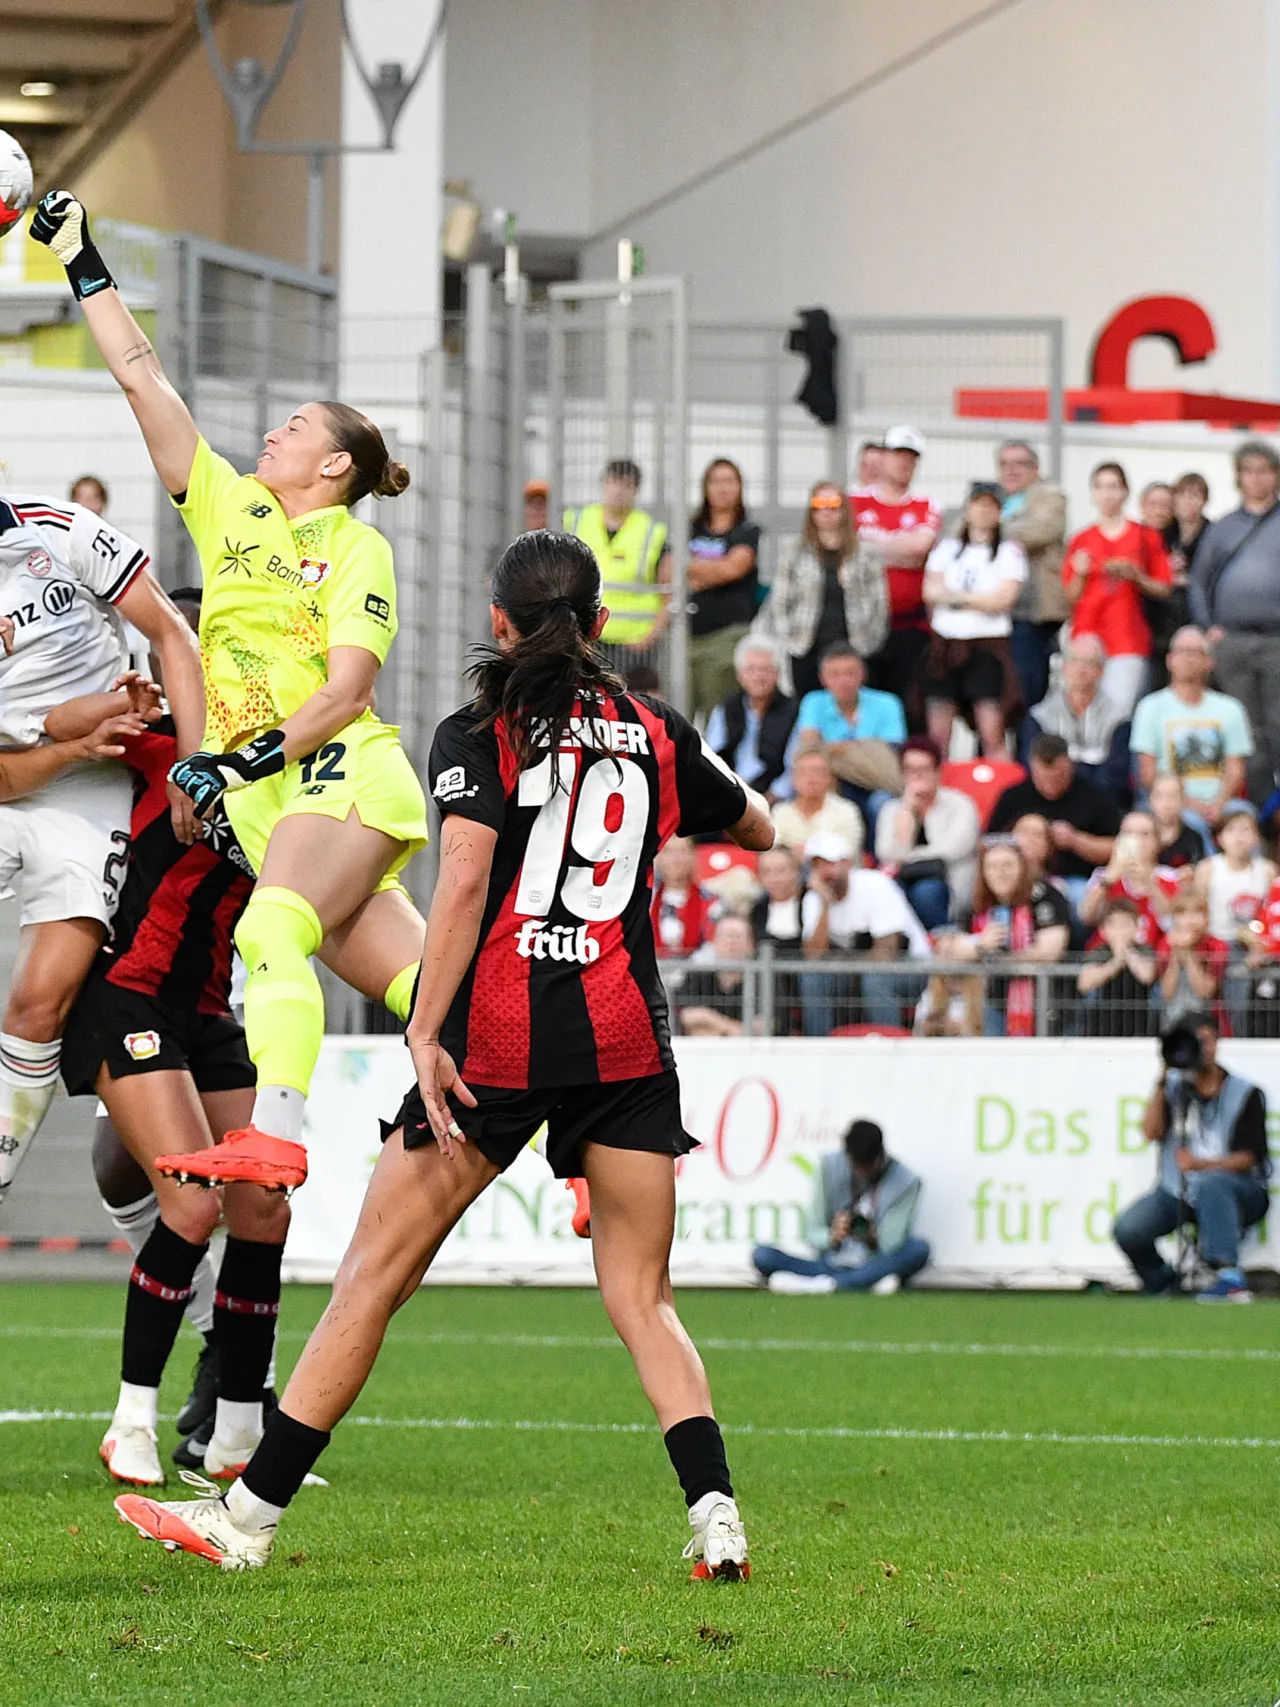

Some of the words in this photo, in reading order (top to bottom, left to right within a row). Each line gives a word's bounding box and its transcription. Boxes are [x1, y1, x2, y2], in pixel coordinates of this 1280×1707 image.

[299, 742, 346, 784] 12
[513, 752, 650, 922] 19
[975, 1095, 1091, 1153] Das
[971, 1179, 1060, 1244] für
